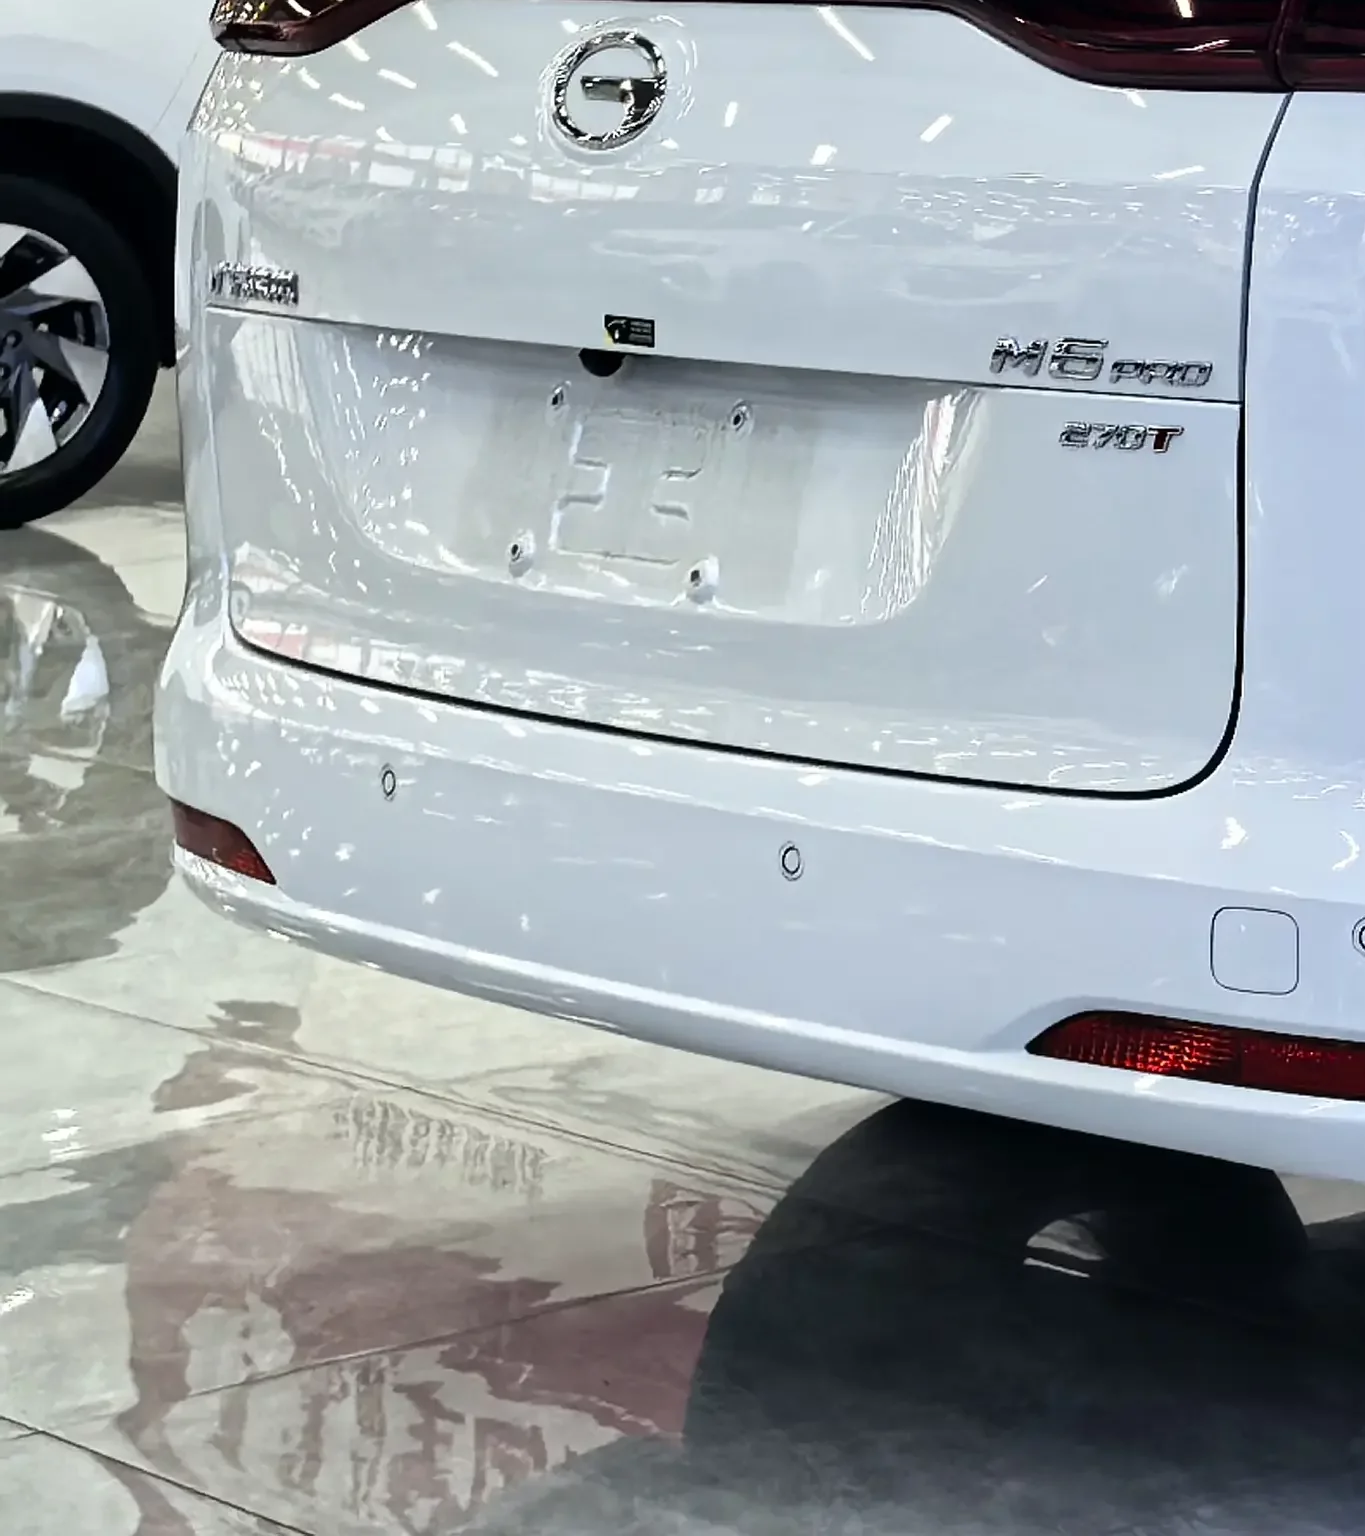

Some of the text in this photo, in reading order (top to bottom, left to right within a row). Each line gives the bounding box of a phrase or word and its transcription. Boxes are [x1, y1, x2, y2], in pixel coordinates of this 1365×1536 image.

[989, 336, 1213, 387] M6 PRO
[1059, 421, 1185, 453] 270T
